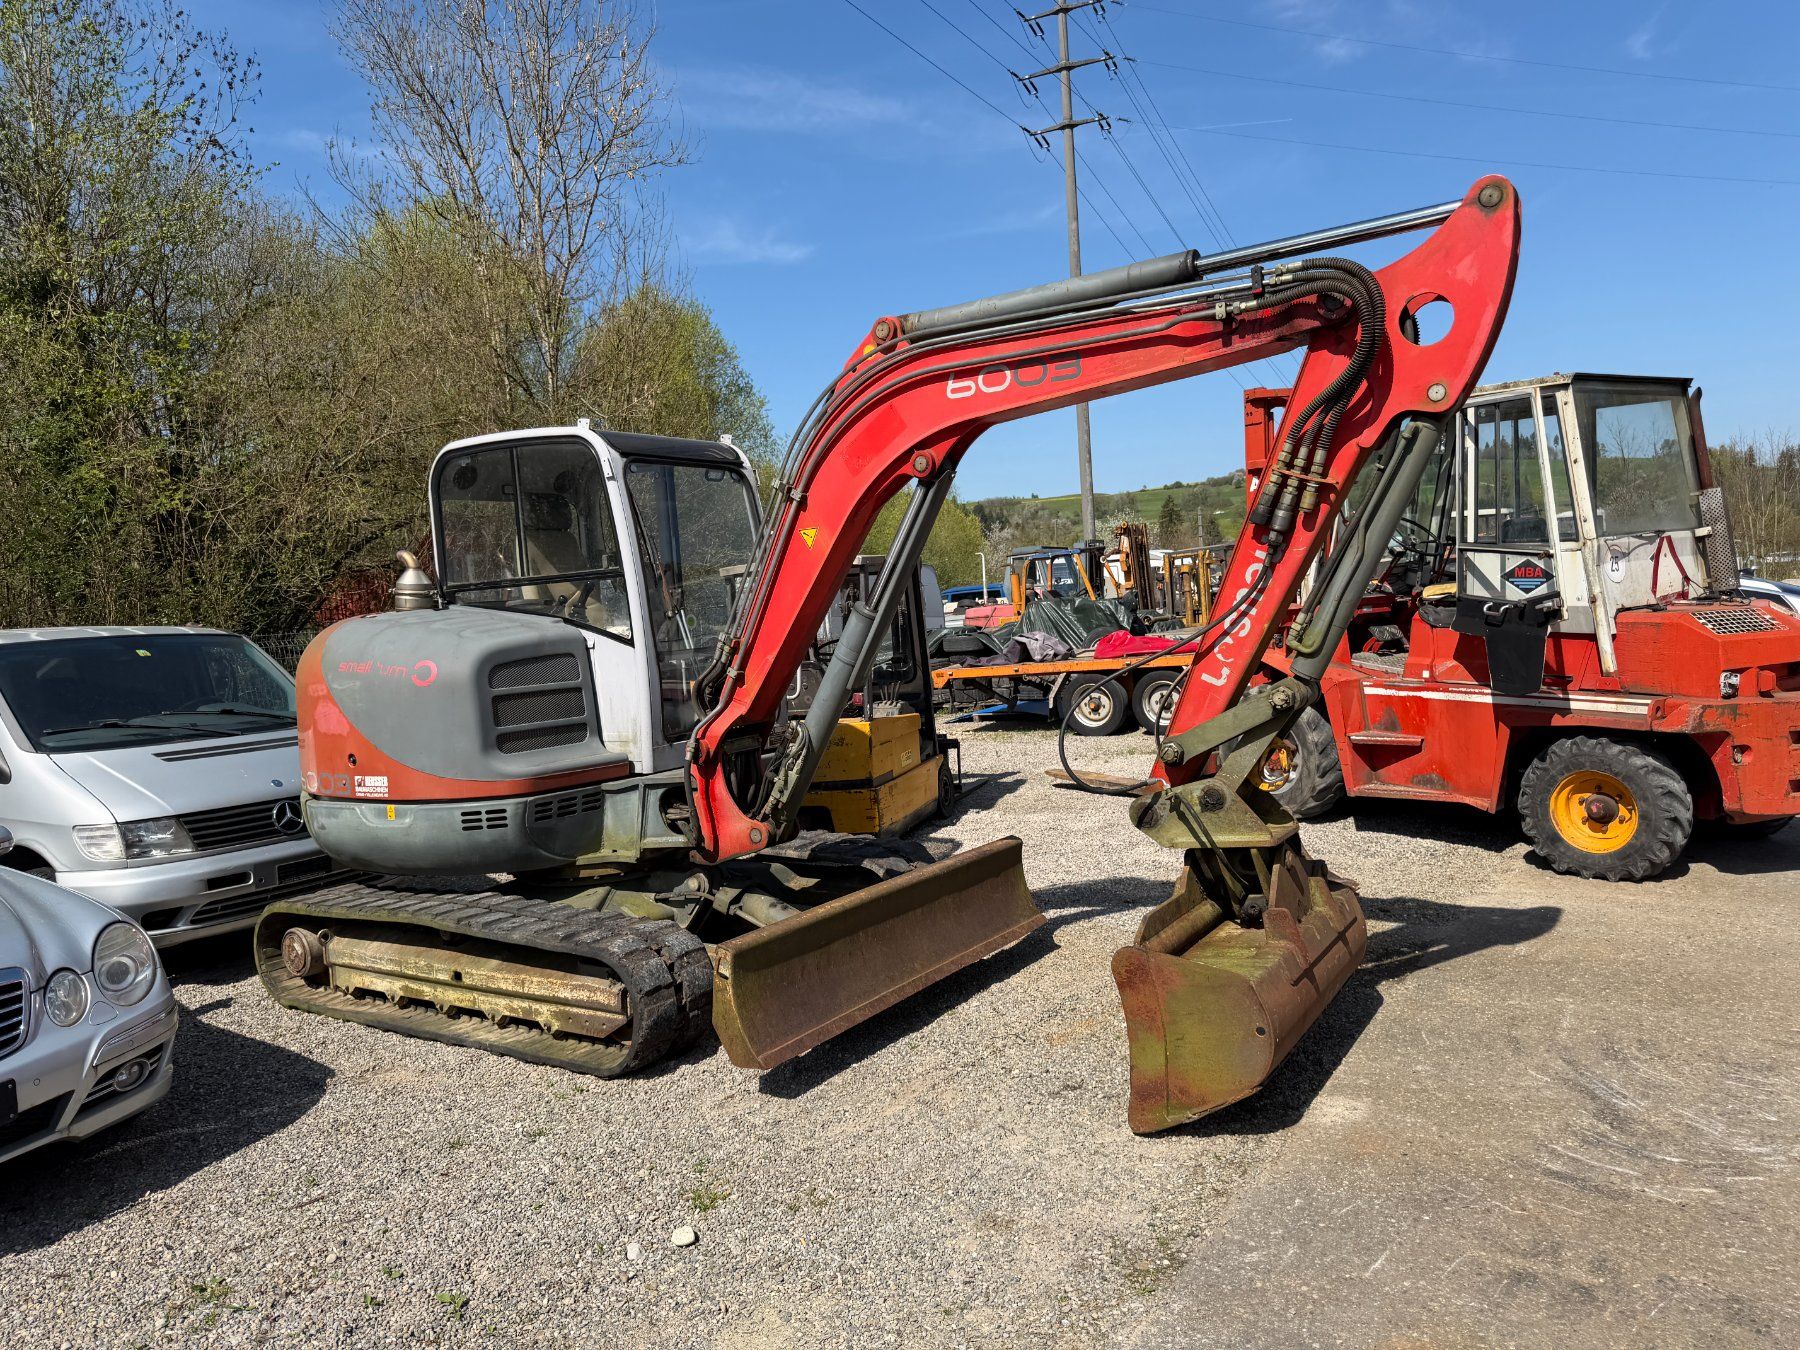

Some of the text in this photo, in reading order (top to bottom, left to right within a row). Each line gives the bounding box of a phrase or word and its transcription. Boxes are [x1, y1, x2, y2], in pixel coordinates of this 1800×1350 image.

[946, 351, 1082, 399] 6003
[1514, 567, 1543, 577] MBA
[1610, 555, 1620, 572] 25
